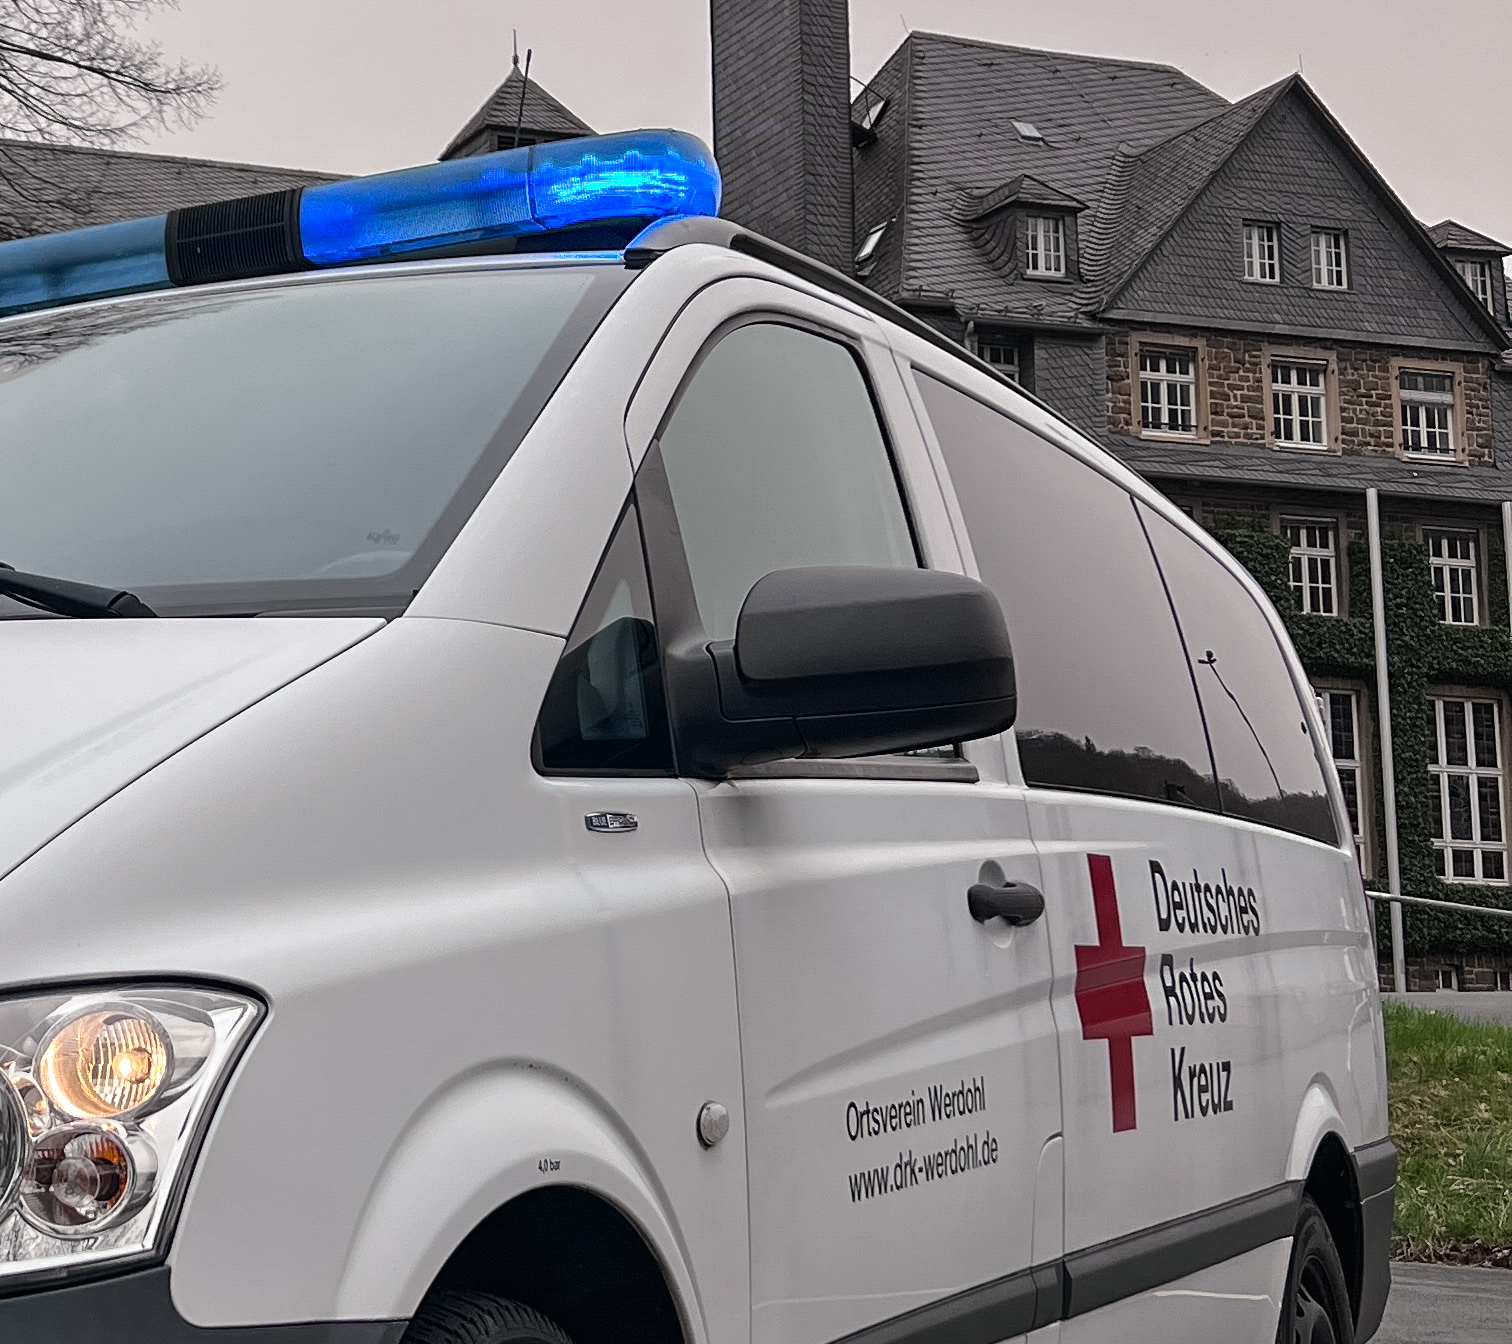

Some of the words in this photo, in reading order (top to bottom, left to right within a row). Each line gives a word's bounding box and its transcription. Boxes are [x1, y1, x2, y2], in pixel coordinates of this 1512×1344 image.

[1149, 859, 1260, 937] Deutsches
[1159, 953, 1228, 1026] Rotes
[846, 1089, 926, 1141] Ortsverein
[927, 1075, 986, 1122] Werdohl
[1170, 1046, 1234, 1122] Kreuz
[549, 1158, 561, 1172] bar
[848, 1129, 999, 1203] www.drk-werdohl.de
